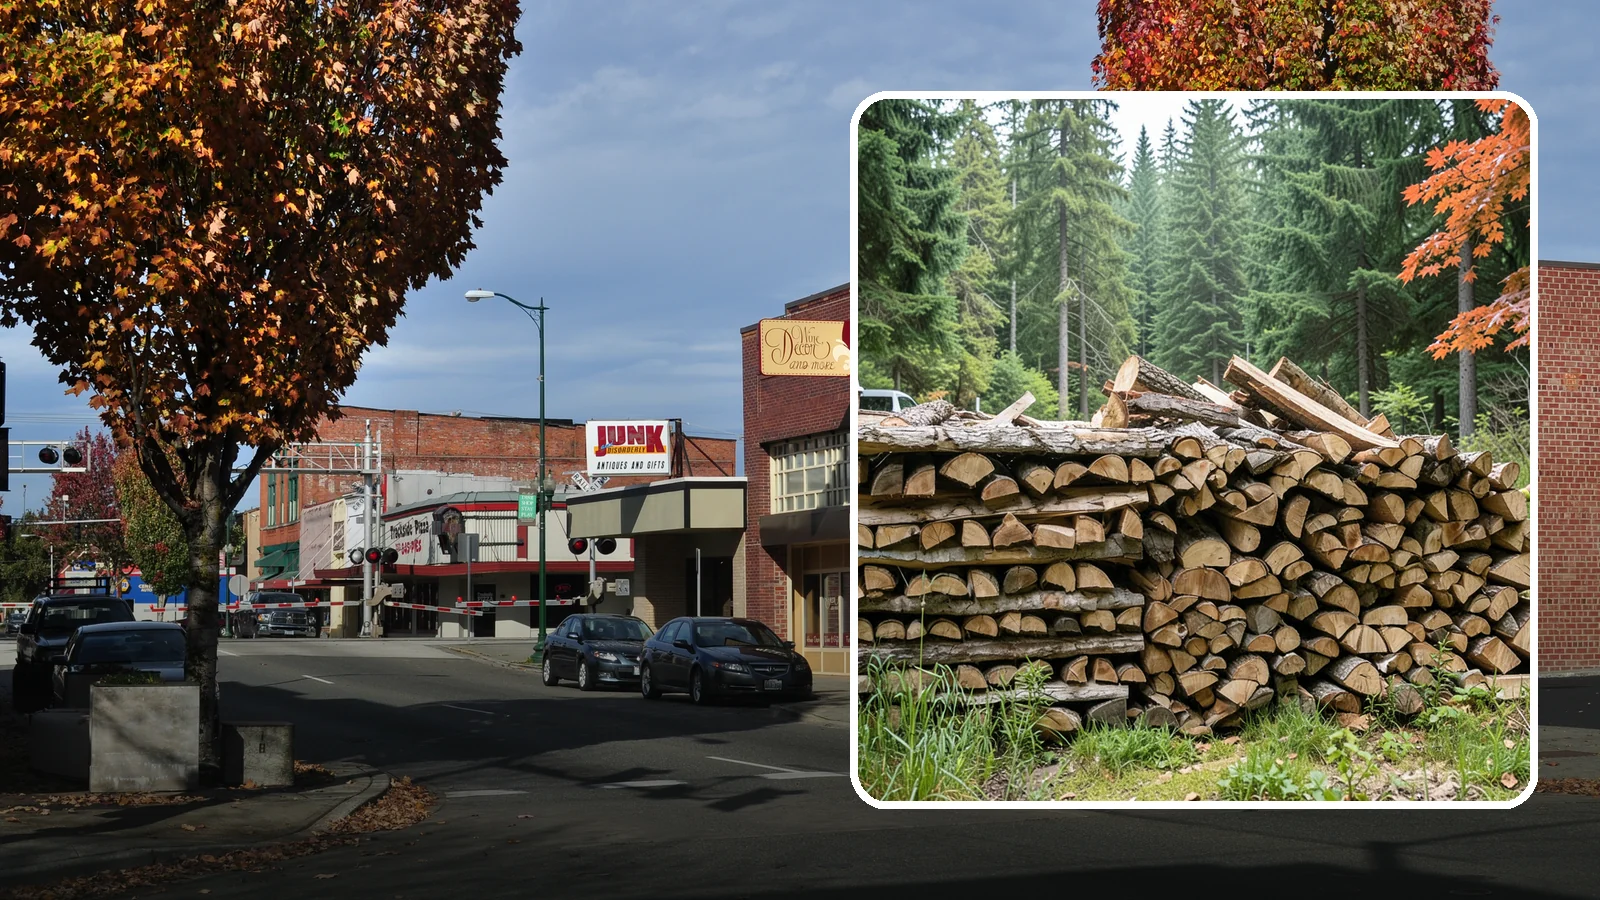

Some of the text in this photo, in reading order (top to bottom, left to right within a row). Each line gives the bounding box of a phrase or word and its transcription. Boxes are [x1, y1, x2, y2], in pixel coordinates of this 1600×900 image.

[595, 425, 665, 457] JUNK
[607, 446, 646, 454] DISORDERLY
[597, 460, 665, 470] ANTIQUES AND GIFTS
[352, 498, 365, 511] CRO
[390, 519, 429, 539] Trackside Pizza
